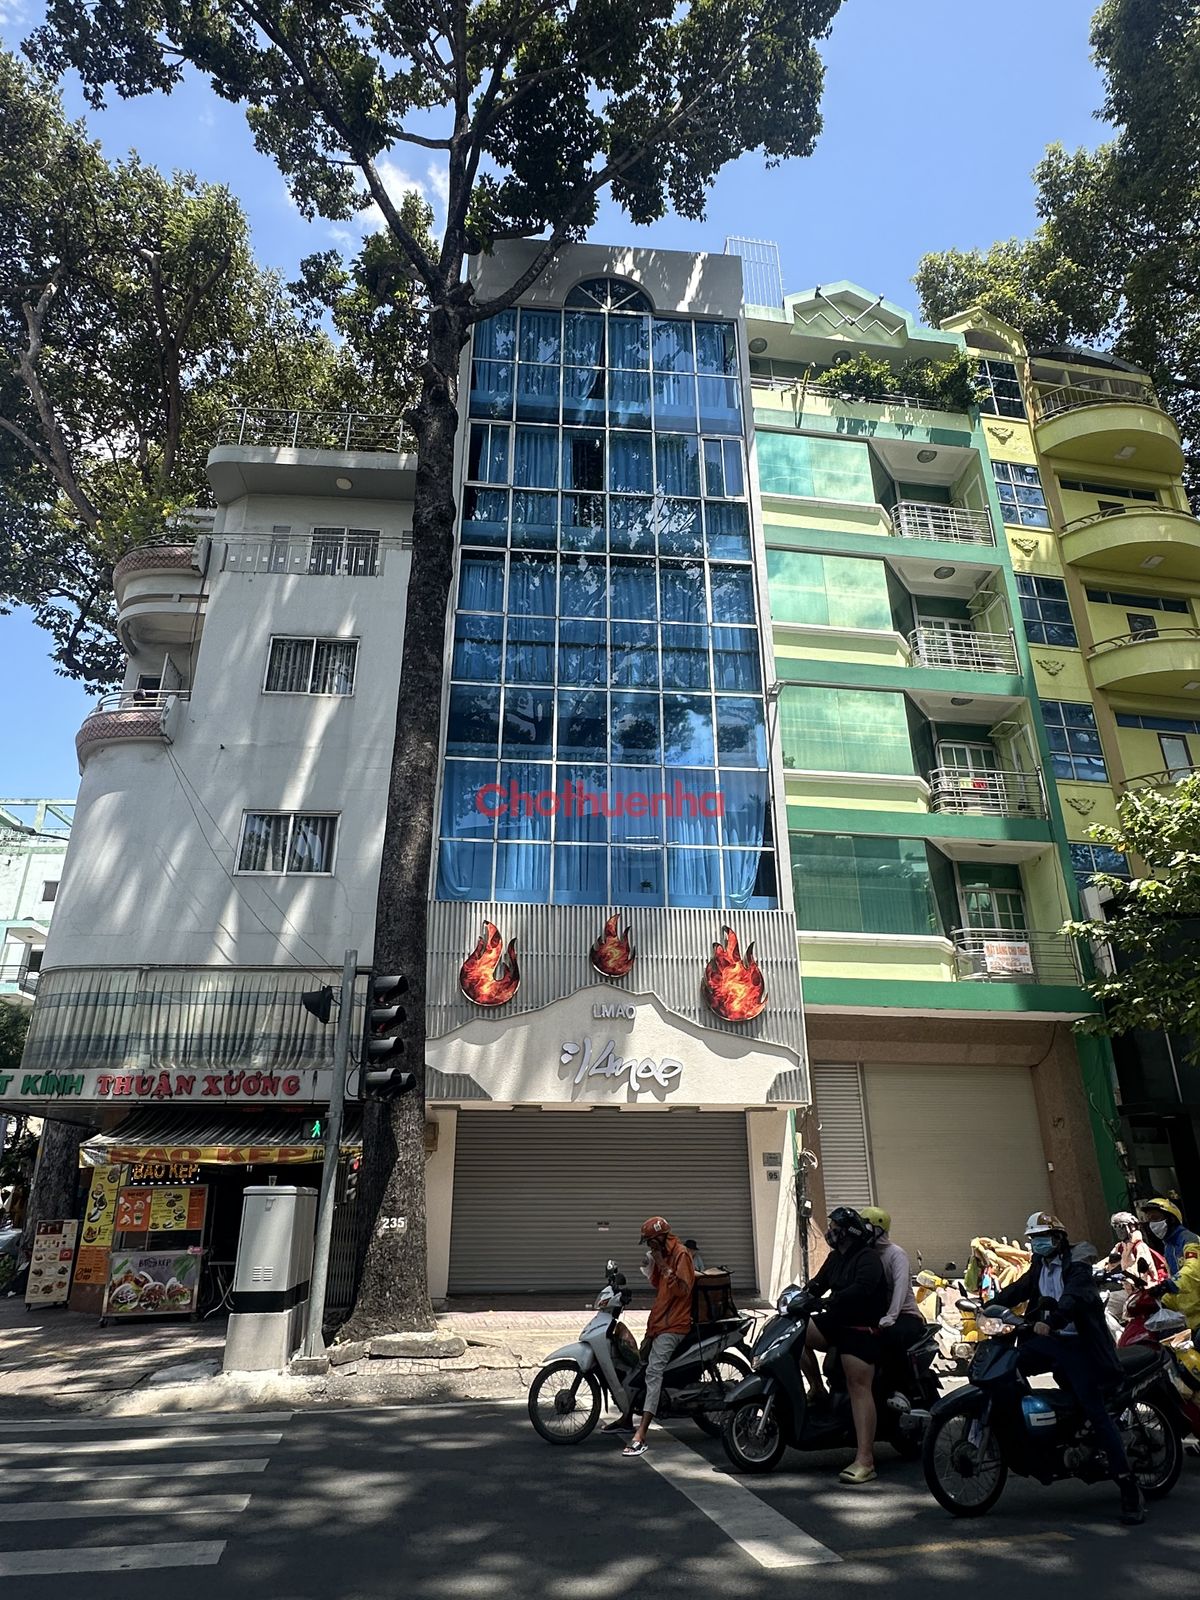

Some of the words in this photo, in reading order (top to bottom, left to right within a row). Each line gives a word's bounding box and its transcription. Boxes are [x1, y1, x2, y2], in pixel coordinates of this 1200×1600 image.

[593, 1003, 637, 1020] LMAO
[97, 1071, 195, 1099] THUẬN
[382, 1216, 406, 1229] 235
